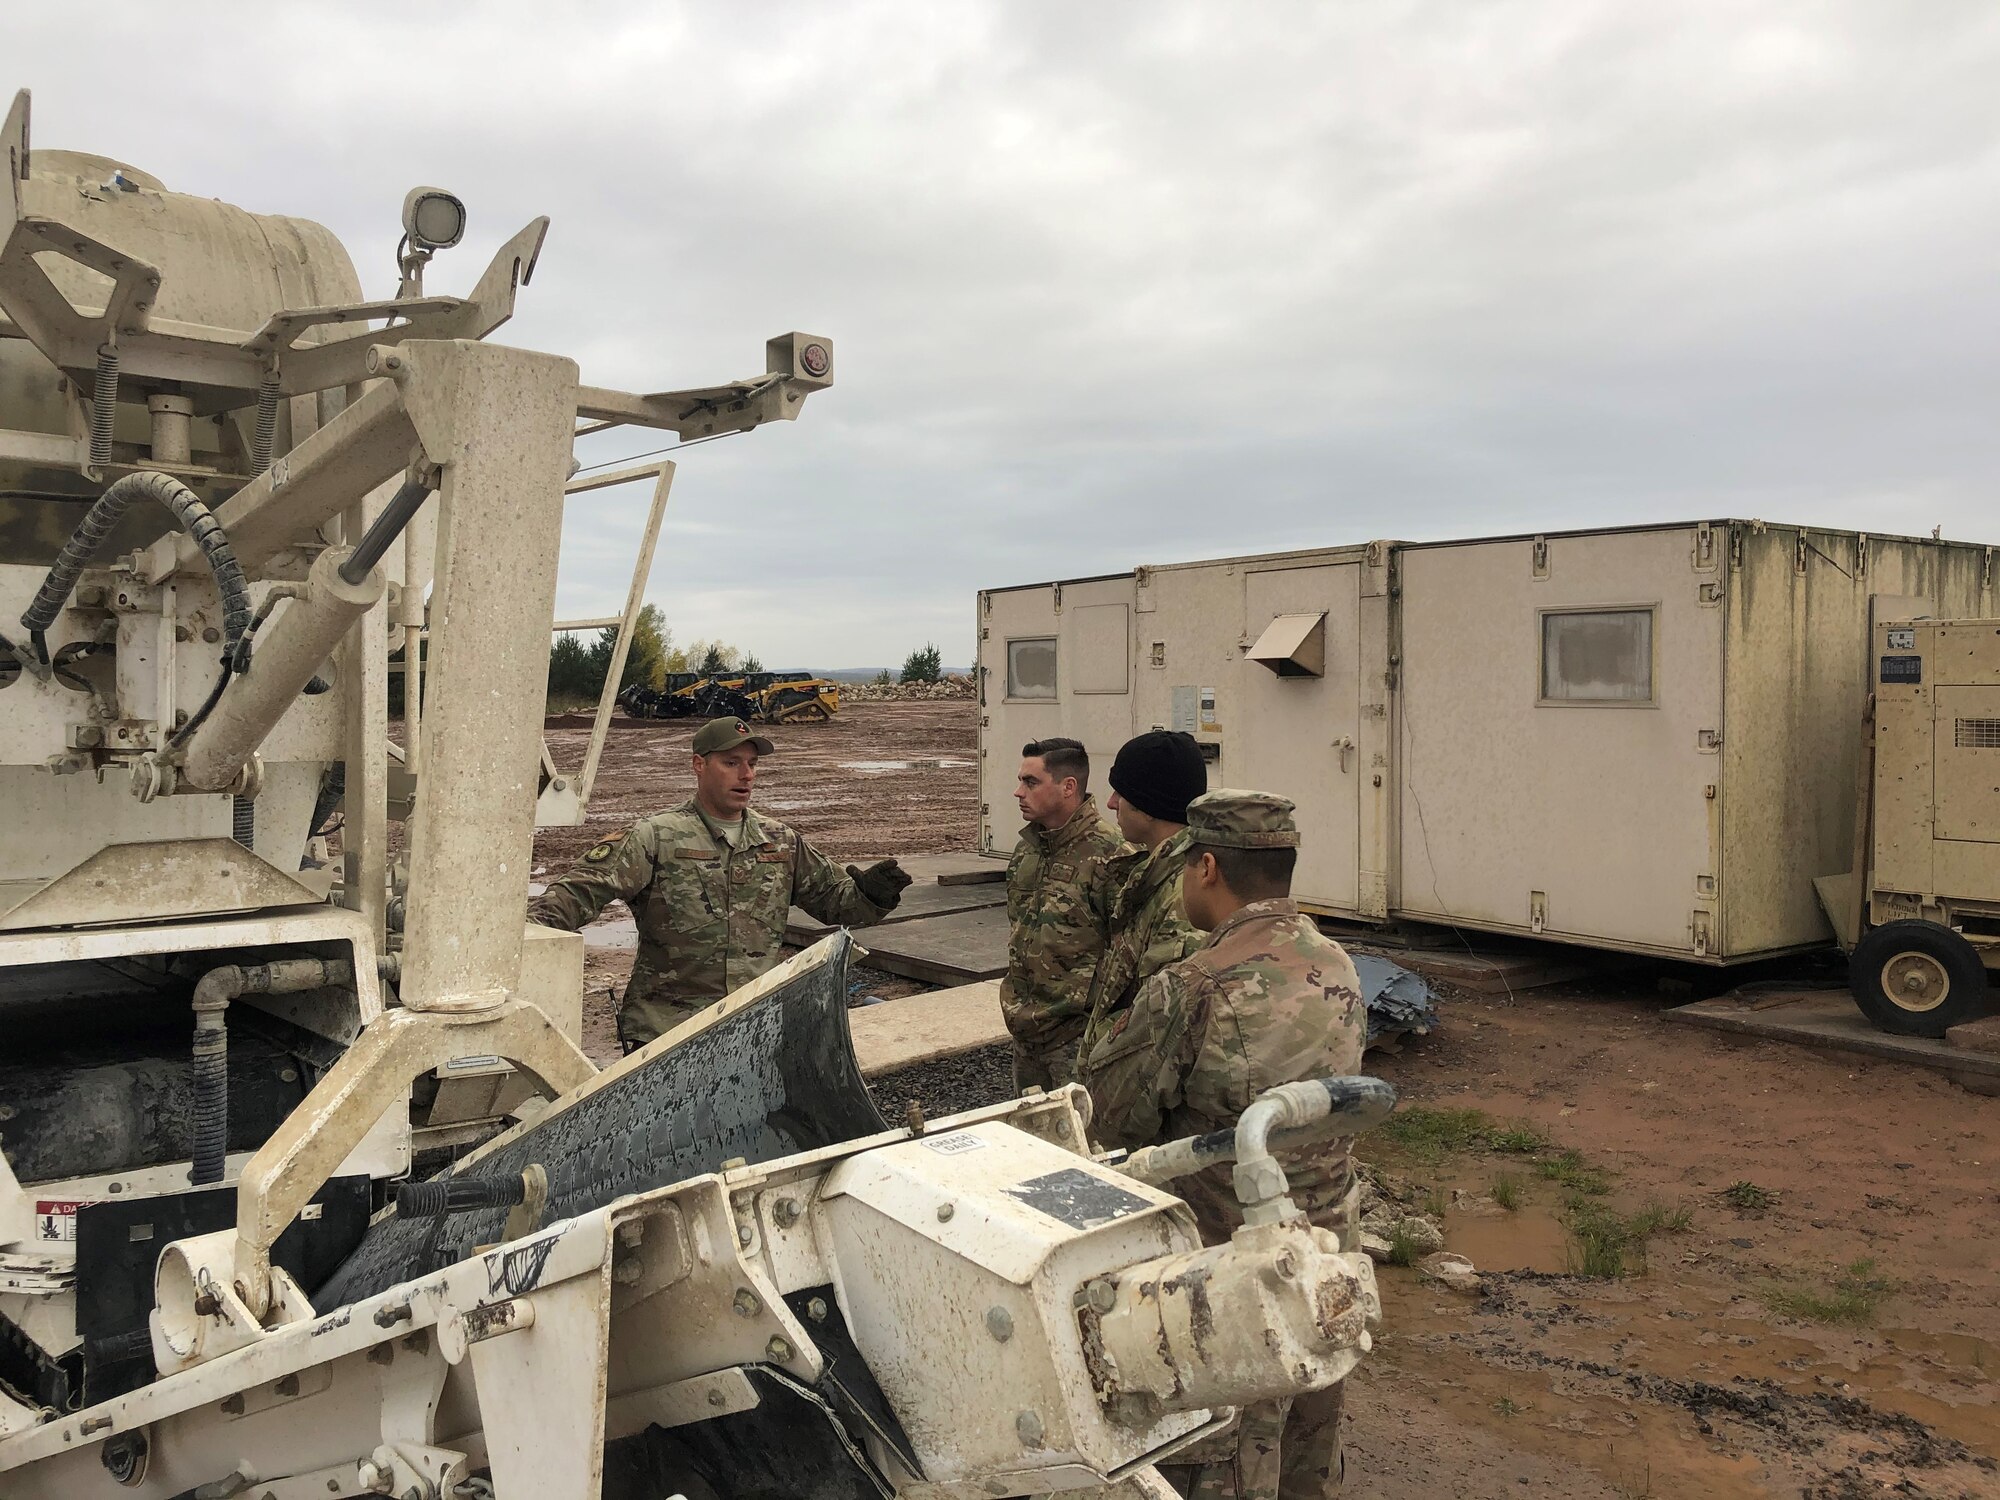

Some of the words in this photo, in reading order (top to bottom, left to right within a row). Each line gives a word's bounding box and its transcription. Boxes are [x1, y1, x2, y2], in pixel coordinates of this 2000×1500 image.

[737, 722, 746, 732] 2
[929, 1135, 972, 1148] GREASE
[944, 1139, 978, 1151] DAILY
